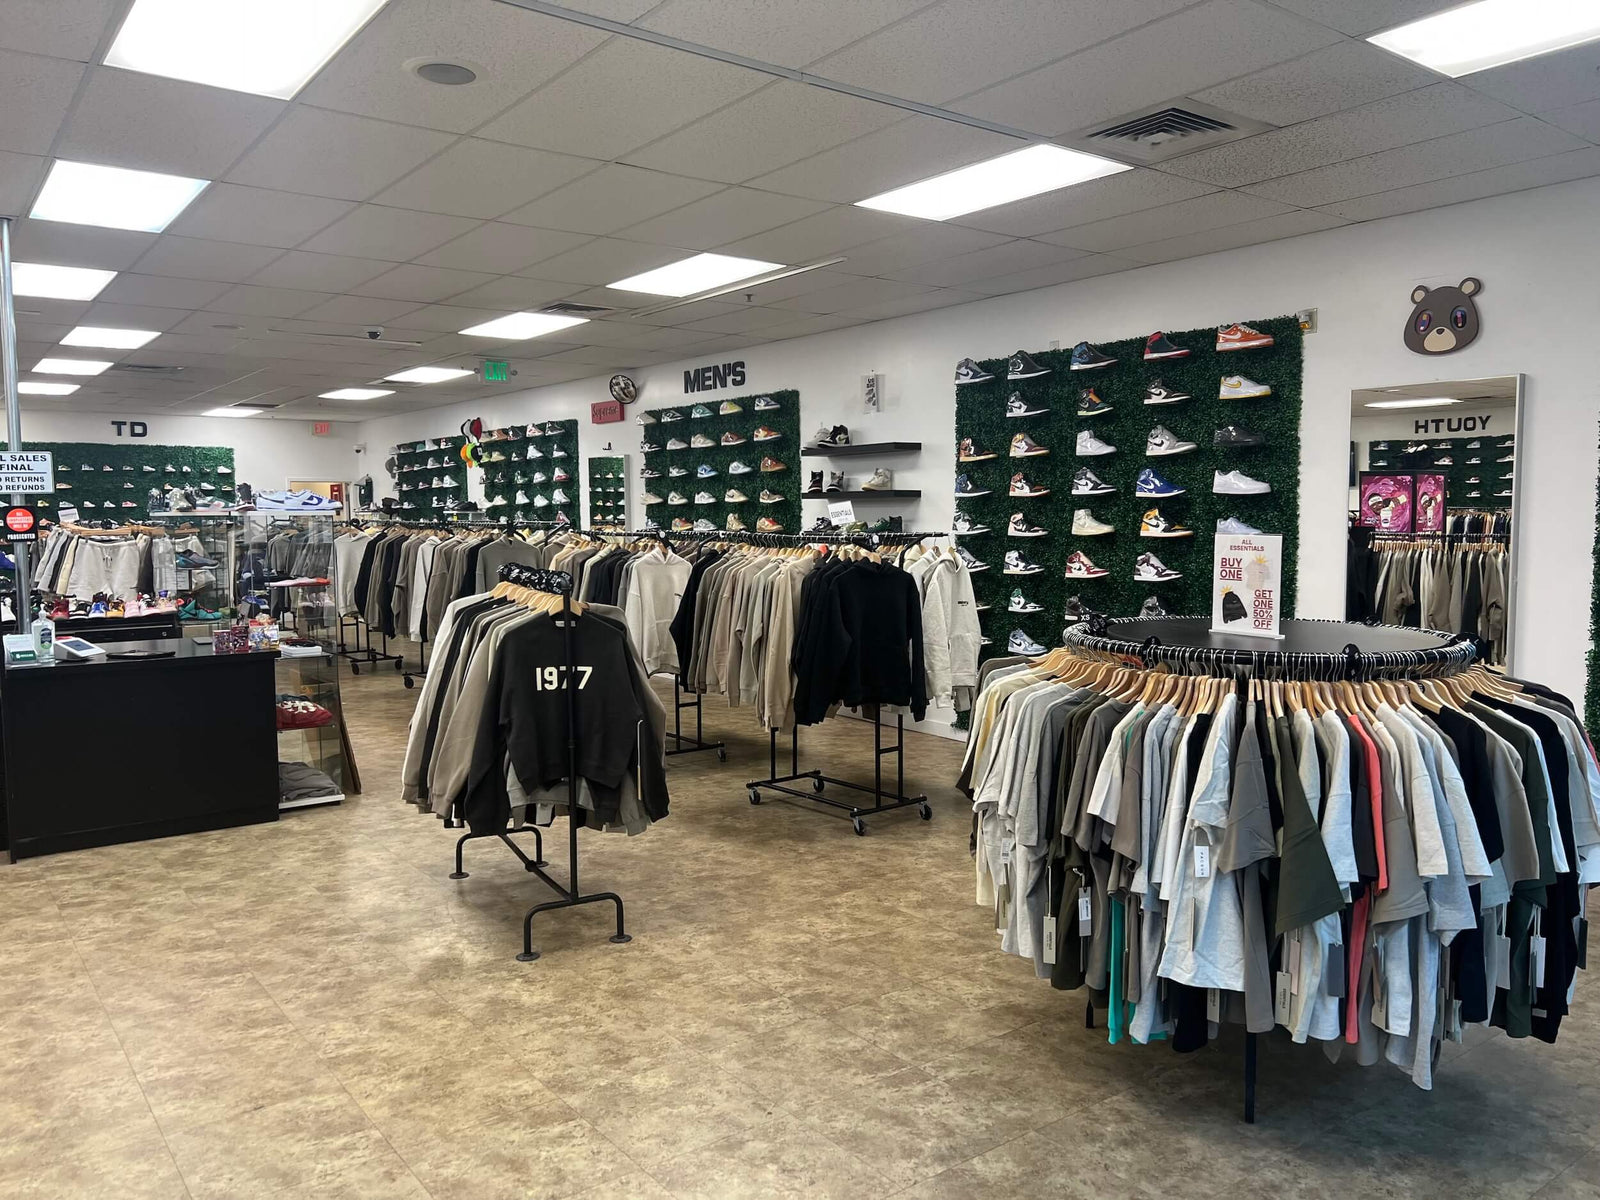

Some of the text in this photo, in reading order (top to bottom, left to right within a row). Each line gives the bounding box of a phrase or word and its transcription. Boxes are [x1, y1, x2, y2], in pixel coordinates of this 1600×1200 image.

[485, 361, 507, 380] EXIT
[683, 361, 746, 394] MEN'S
[111, 421, 148, 437] TD
[10, 454, 47, 462] SALES
[1220, 557, 1243, 567] BUY
[1220, 569, 1243, 579] ONE
[1254, 589, 1273, 598] GET
[1253, 599, 1273, 609] ONE
[1253, 609, 1273, 619] 50%
[1253, 619, 1272, 628] OFF
